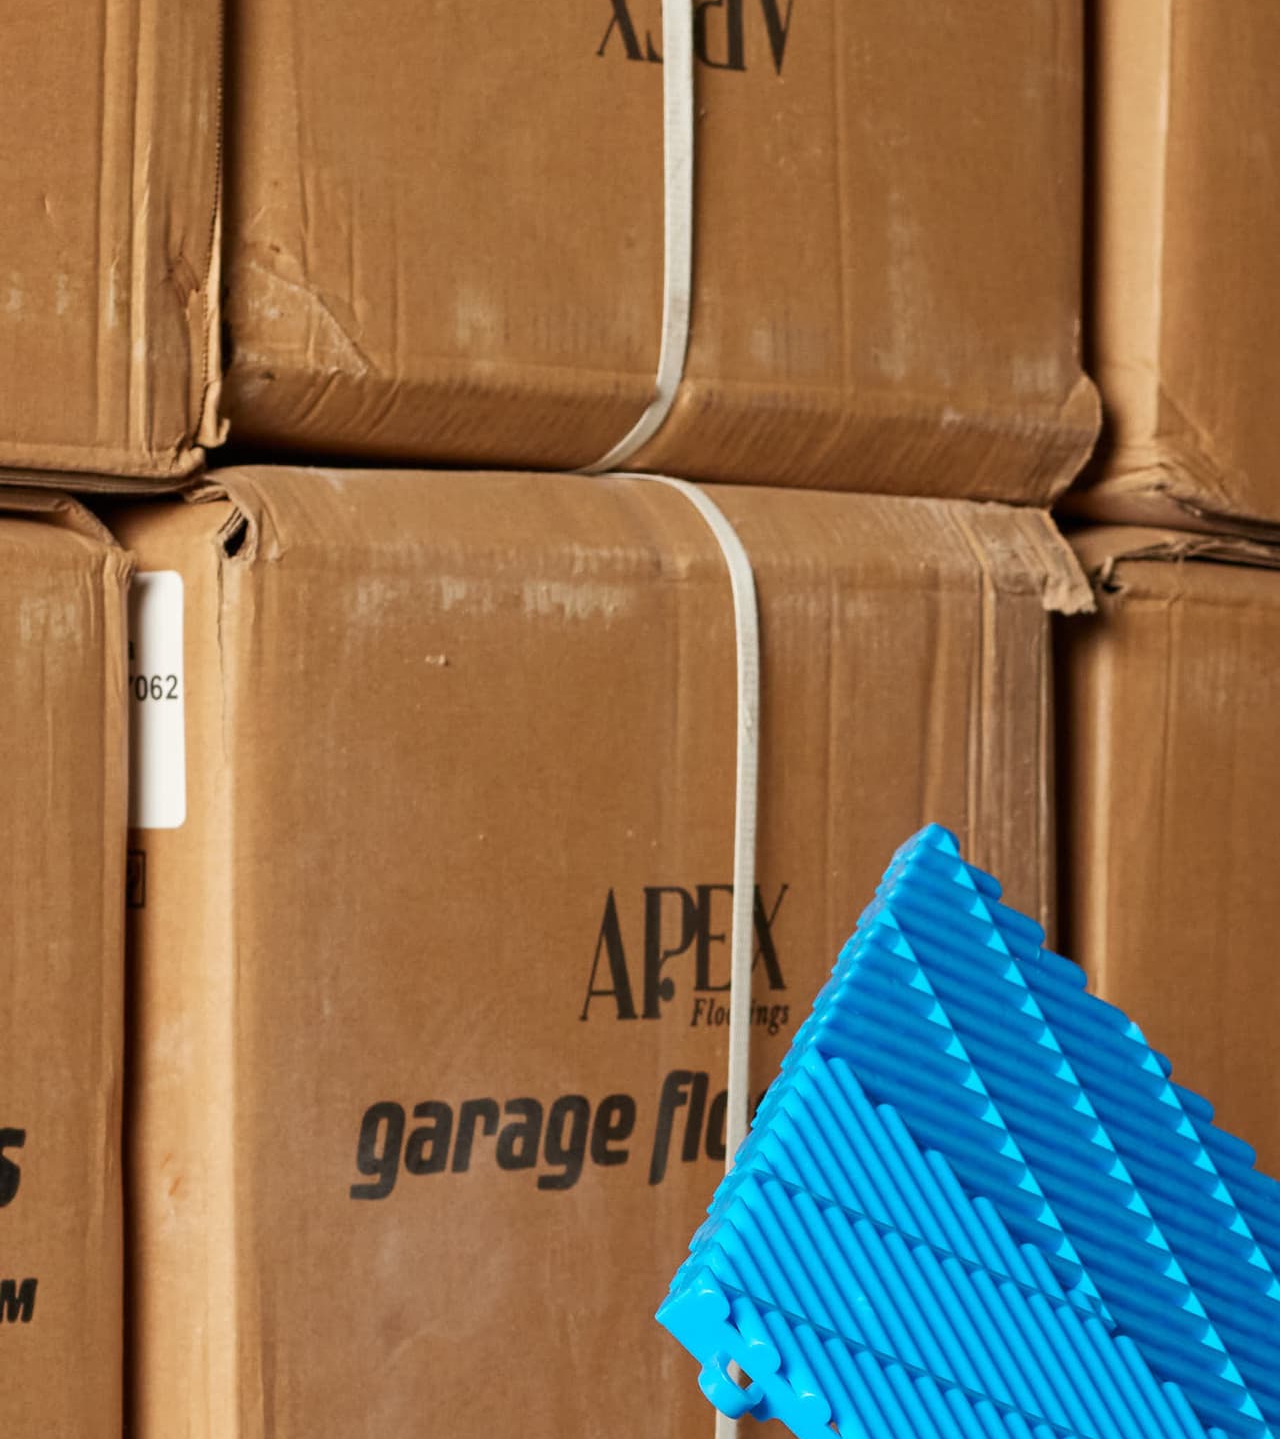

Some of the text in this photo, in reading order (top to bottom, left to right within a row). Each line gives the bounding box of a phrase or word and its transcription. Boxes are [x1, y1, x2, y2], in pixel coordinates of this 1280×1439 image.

[130, 673, 179, 702] 062
[350, 1069, 764, 1200] garage flo
